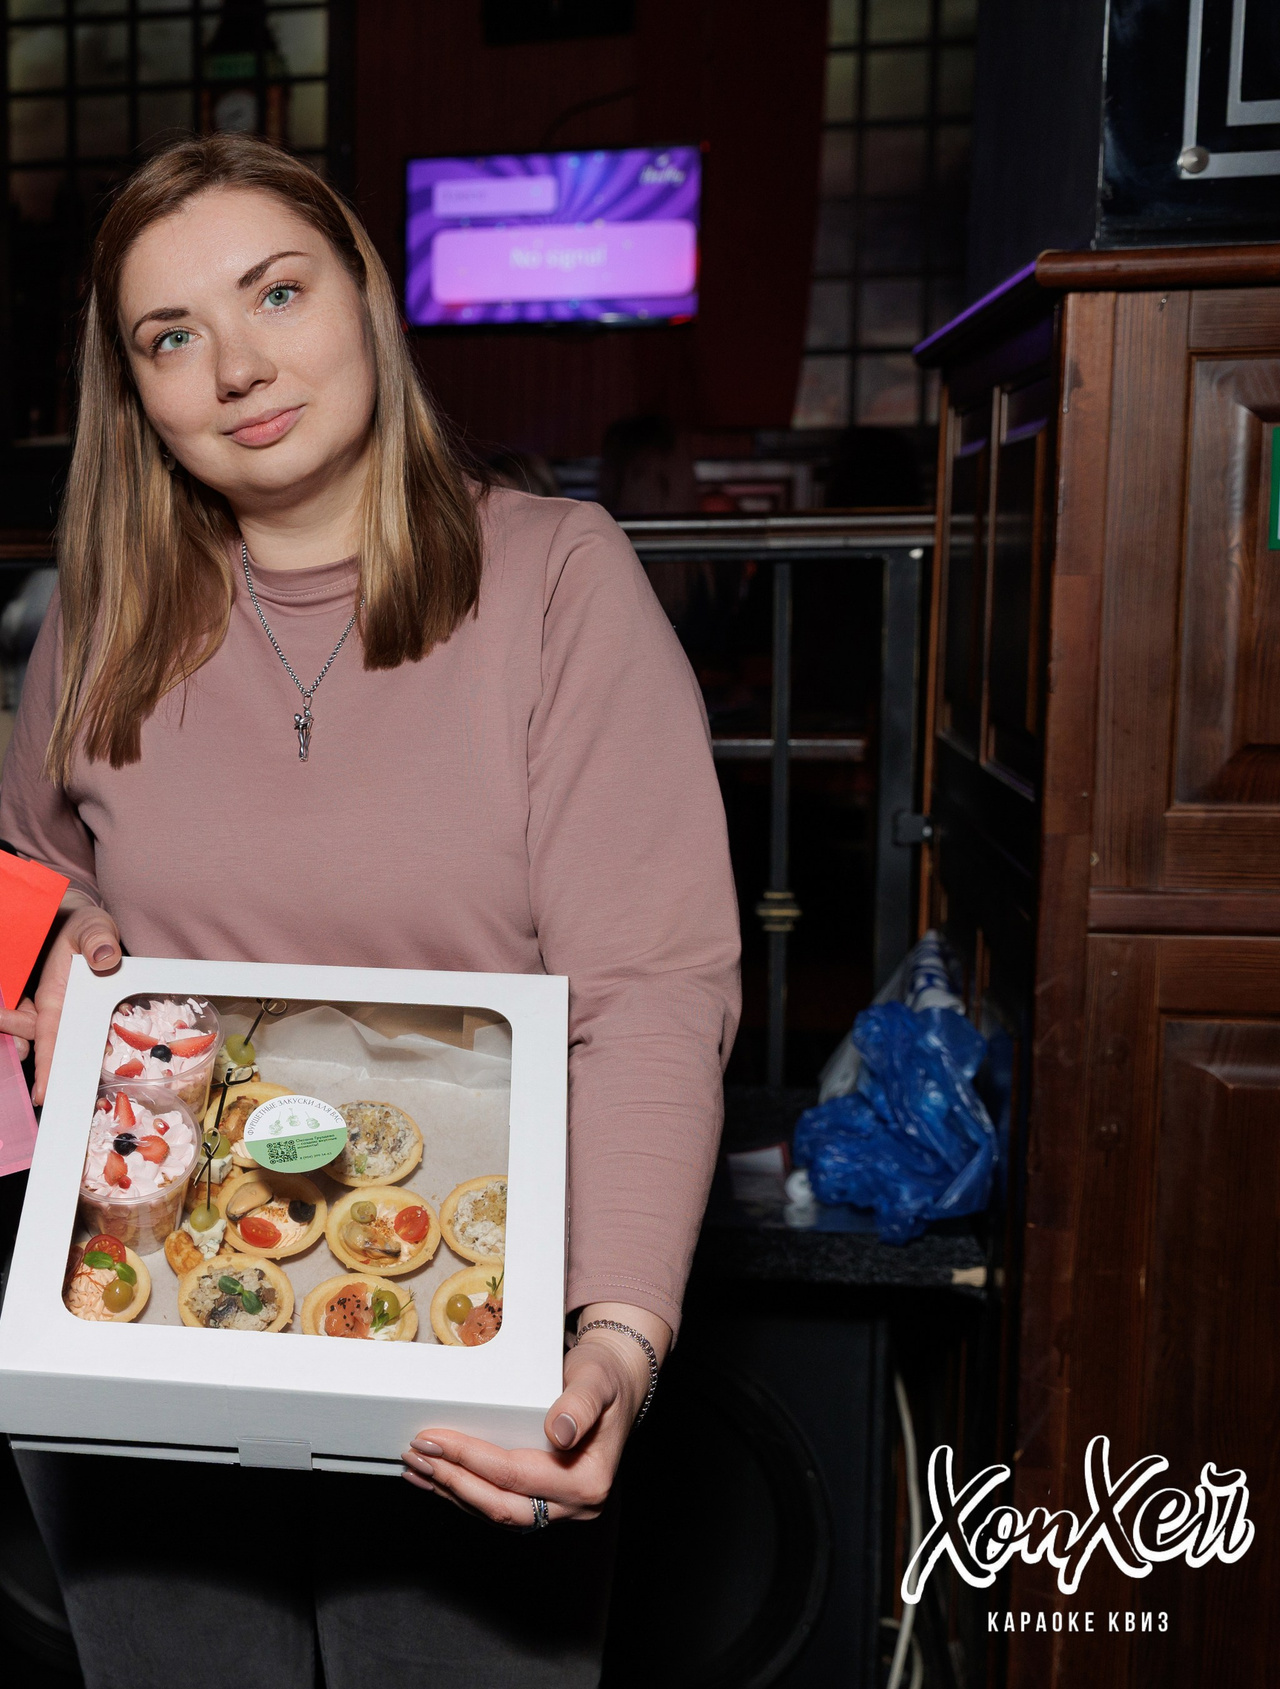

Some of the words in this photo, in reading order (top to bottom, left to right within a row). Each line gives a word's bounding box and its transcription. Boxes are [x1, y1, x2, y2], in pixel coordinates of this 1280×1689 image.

[247, 1102, 278, 1136] ФУРШЕТНЫЕ
[278, 1097, 314, 1106] ЗАКУСКИ
[315, 1102, 331, 1113] ДЛЯ
[330, 1110, 343, 1124] ВАС
